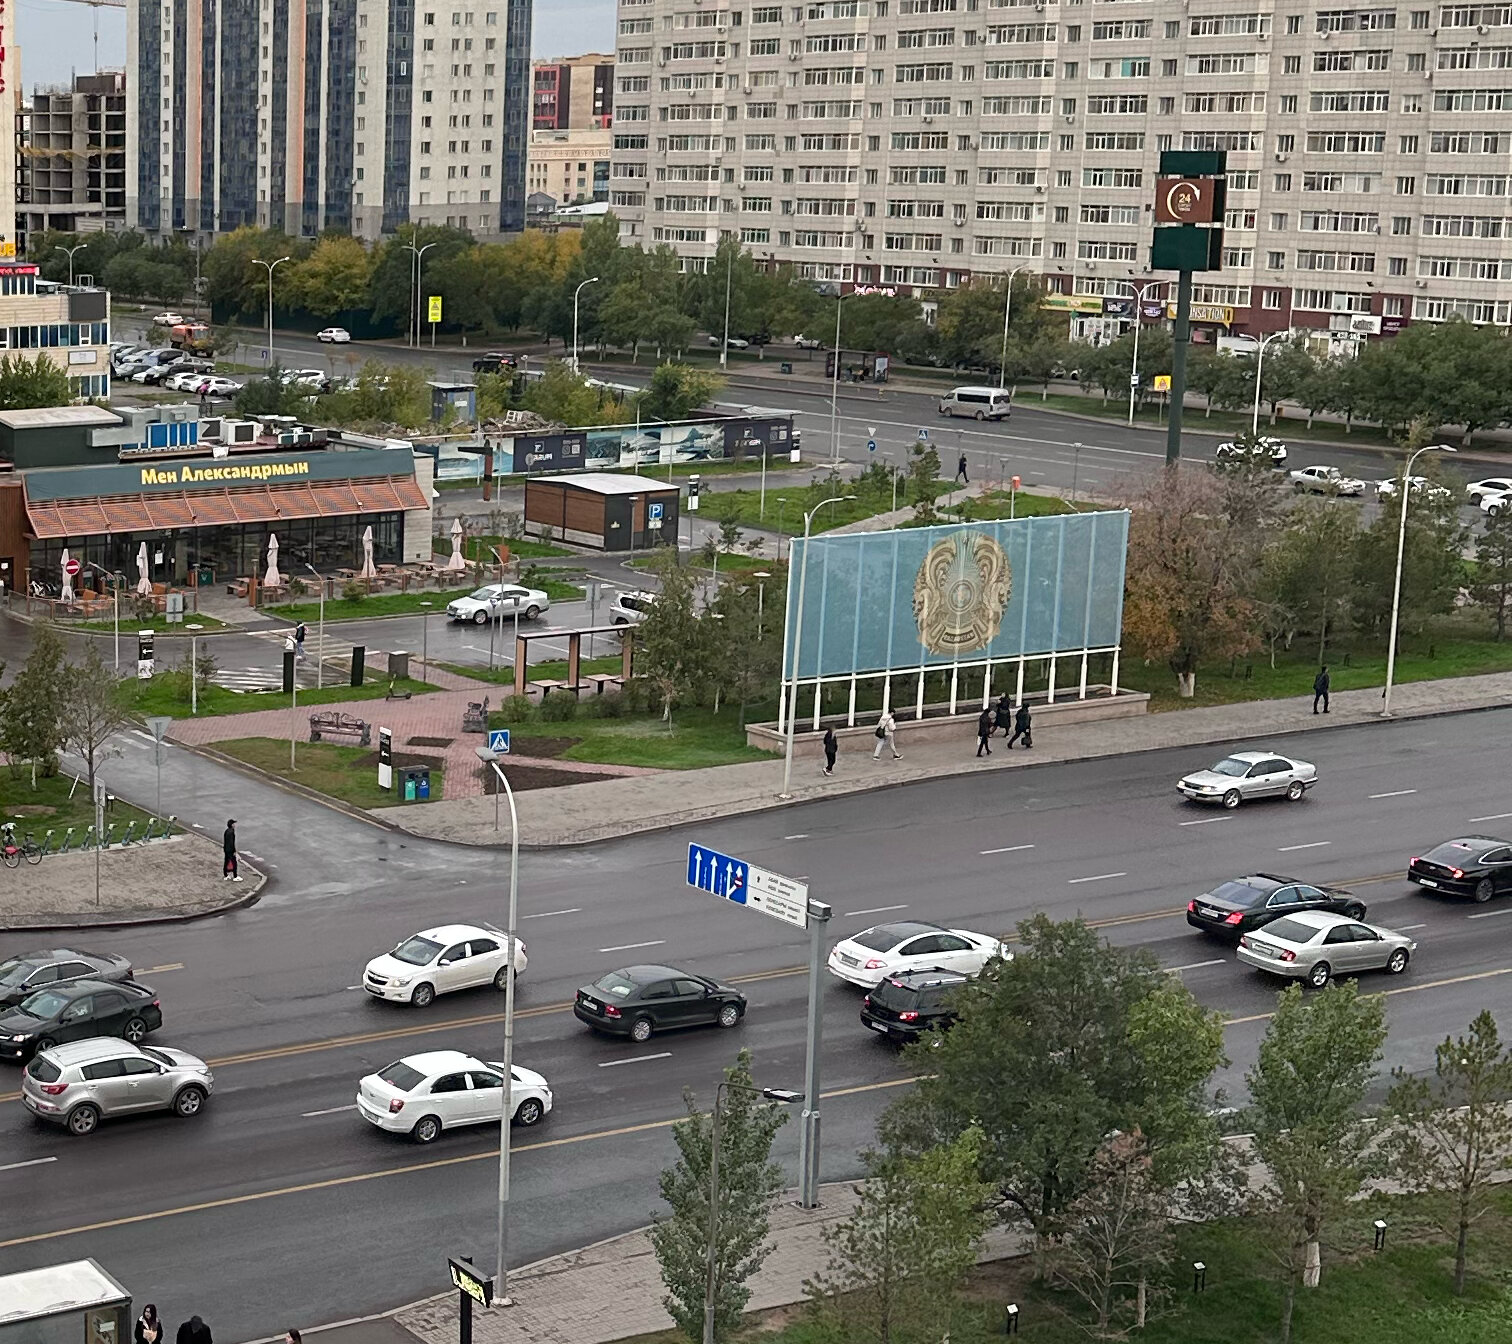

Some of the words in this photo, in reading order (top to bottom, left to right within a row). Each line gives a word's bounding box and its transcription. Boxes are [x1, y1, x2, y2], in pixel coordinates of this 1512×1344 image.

[1178, 193, 1191, 204] 24
[141, 468, 178, 485] Мен
[181, 461, 310, 483] Александрмын
